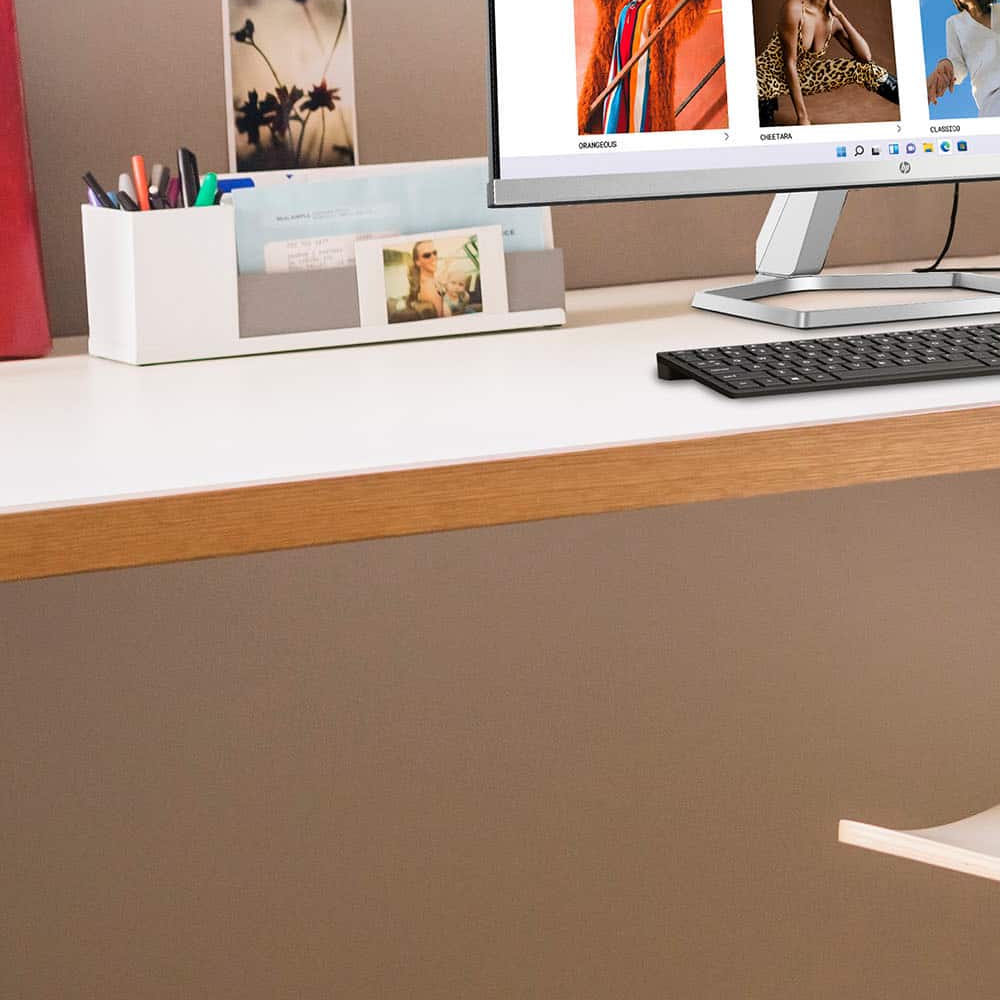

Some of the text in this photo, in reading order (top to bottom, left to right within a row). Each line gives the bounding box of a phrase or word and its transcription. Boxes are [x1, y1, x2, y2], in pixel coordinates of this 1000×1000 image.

[930, 125, 960, 133] CLASSICO
[760, 133, 792, 141] CHEETARA
[579, 141, 617, 149] ORANGEOUS
